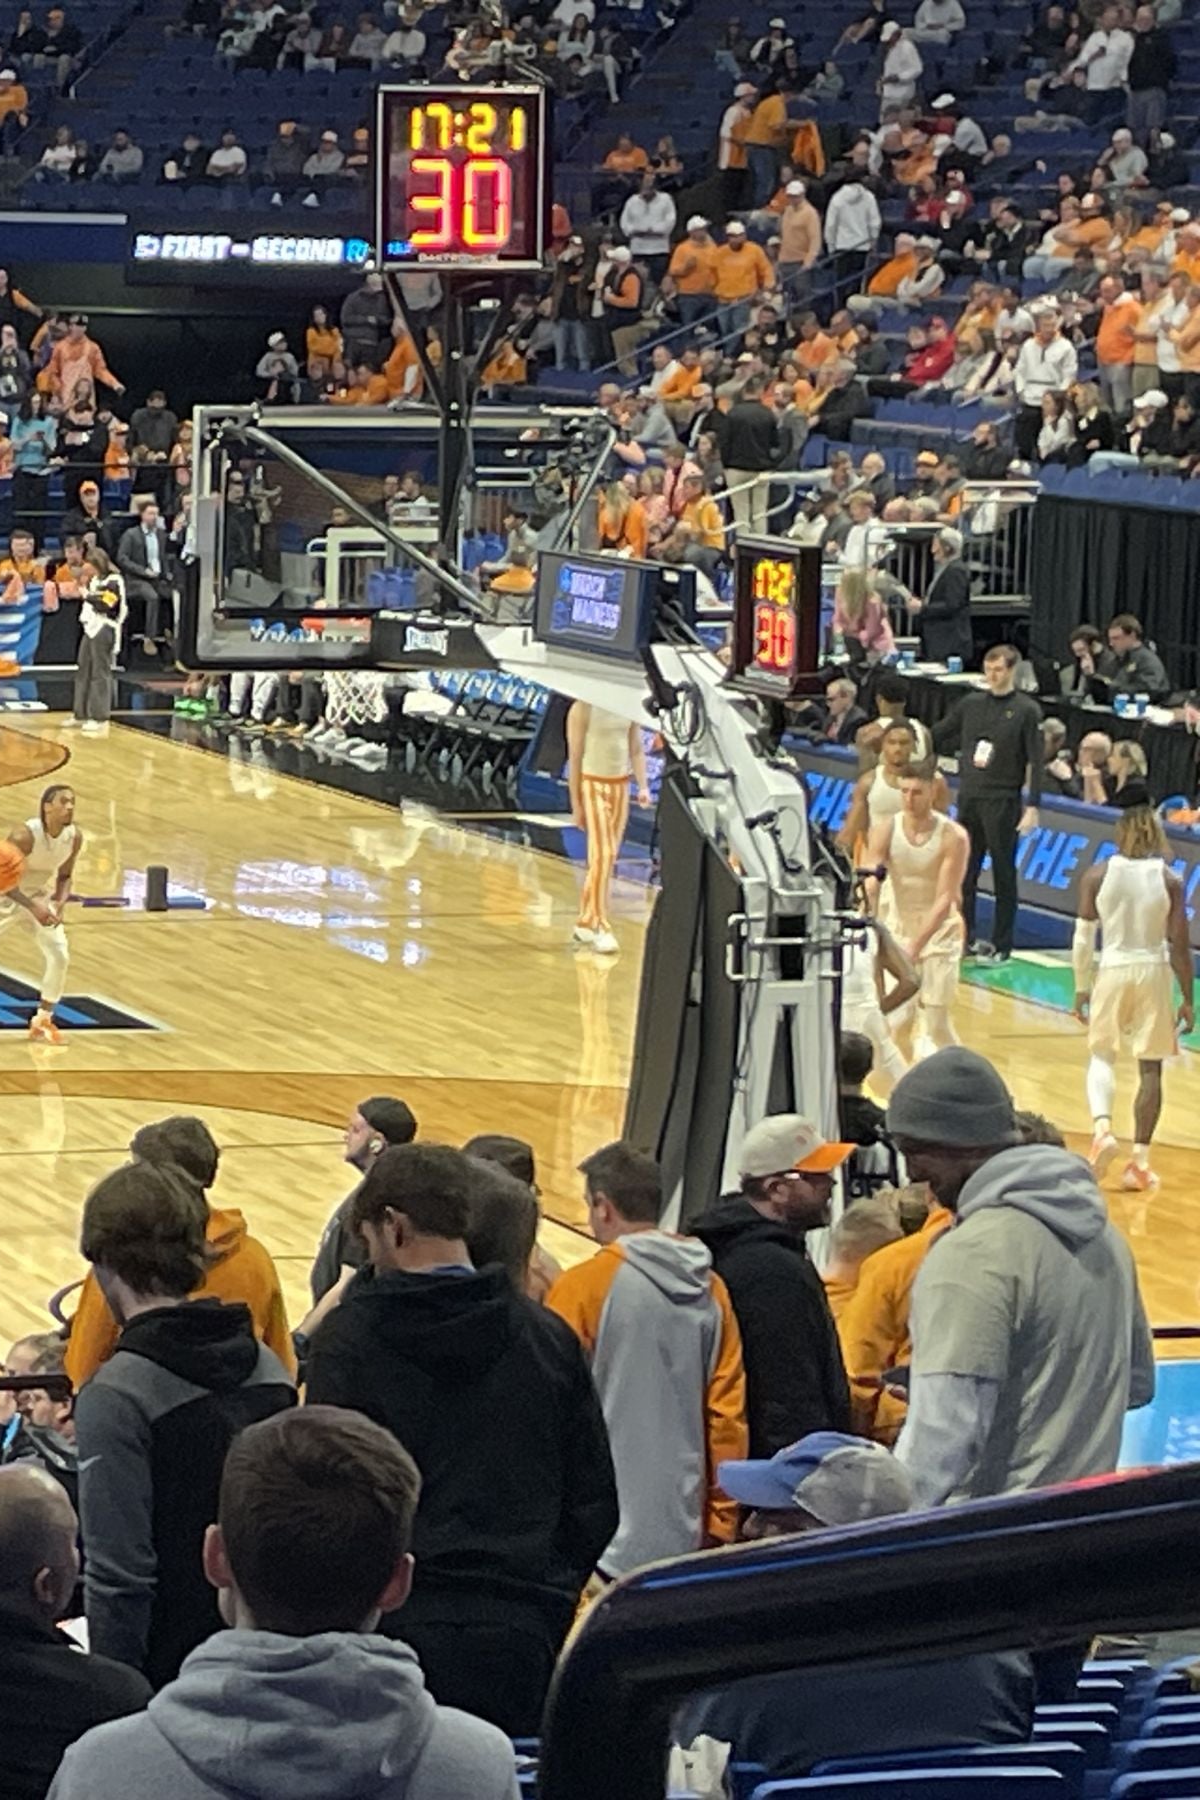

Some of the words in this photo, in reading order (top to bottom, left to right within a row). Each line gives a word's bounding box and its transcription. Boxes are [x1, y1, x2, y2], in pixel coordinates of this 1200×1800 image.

[411, 102, 524, 153] 17:21
[410, 158, 511, 247] 30
[161, 235, 231, 260] FIRST
[252, 237, 344, 263] SECOND
[756, 608, 795, 667] 30
